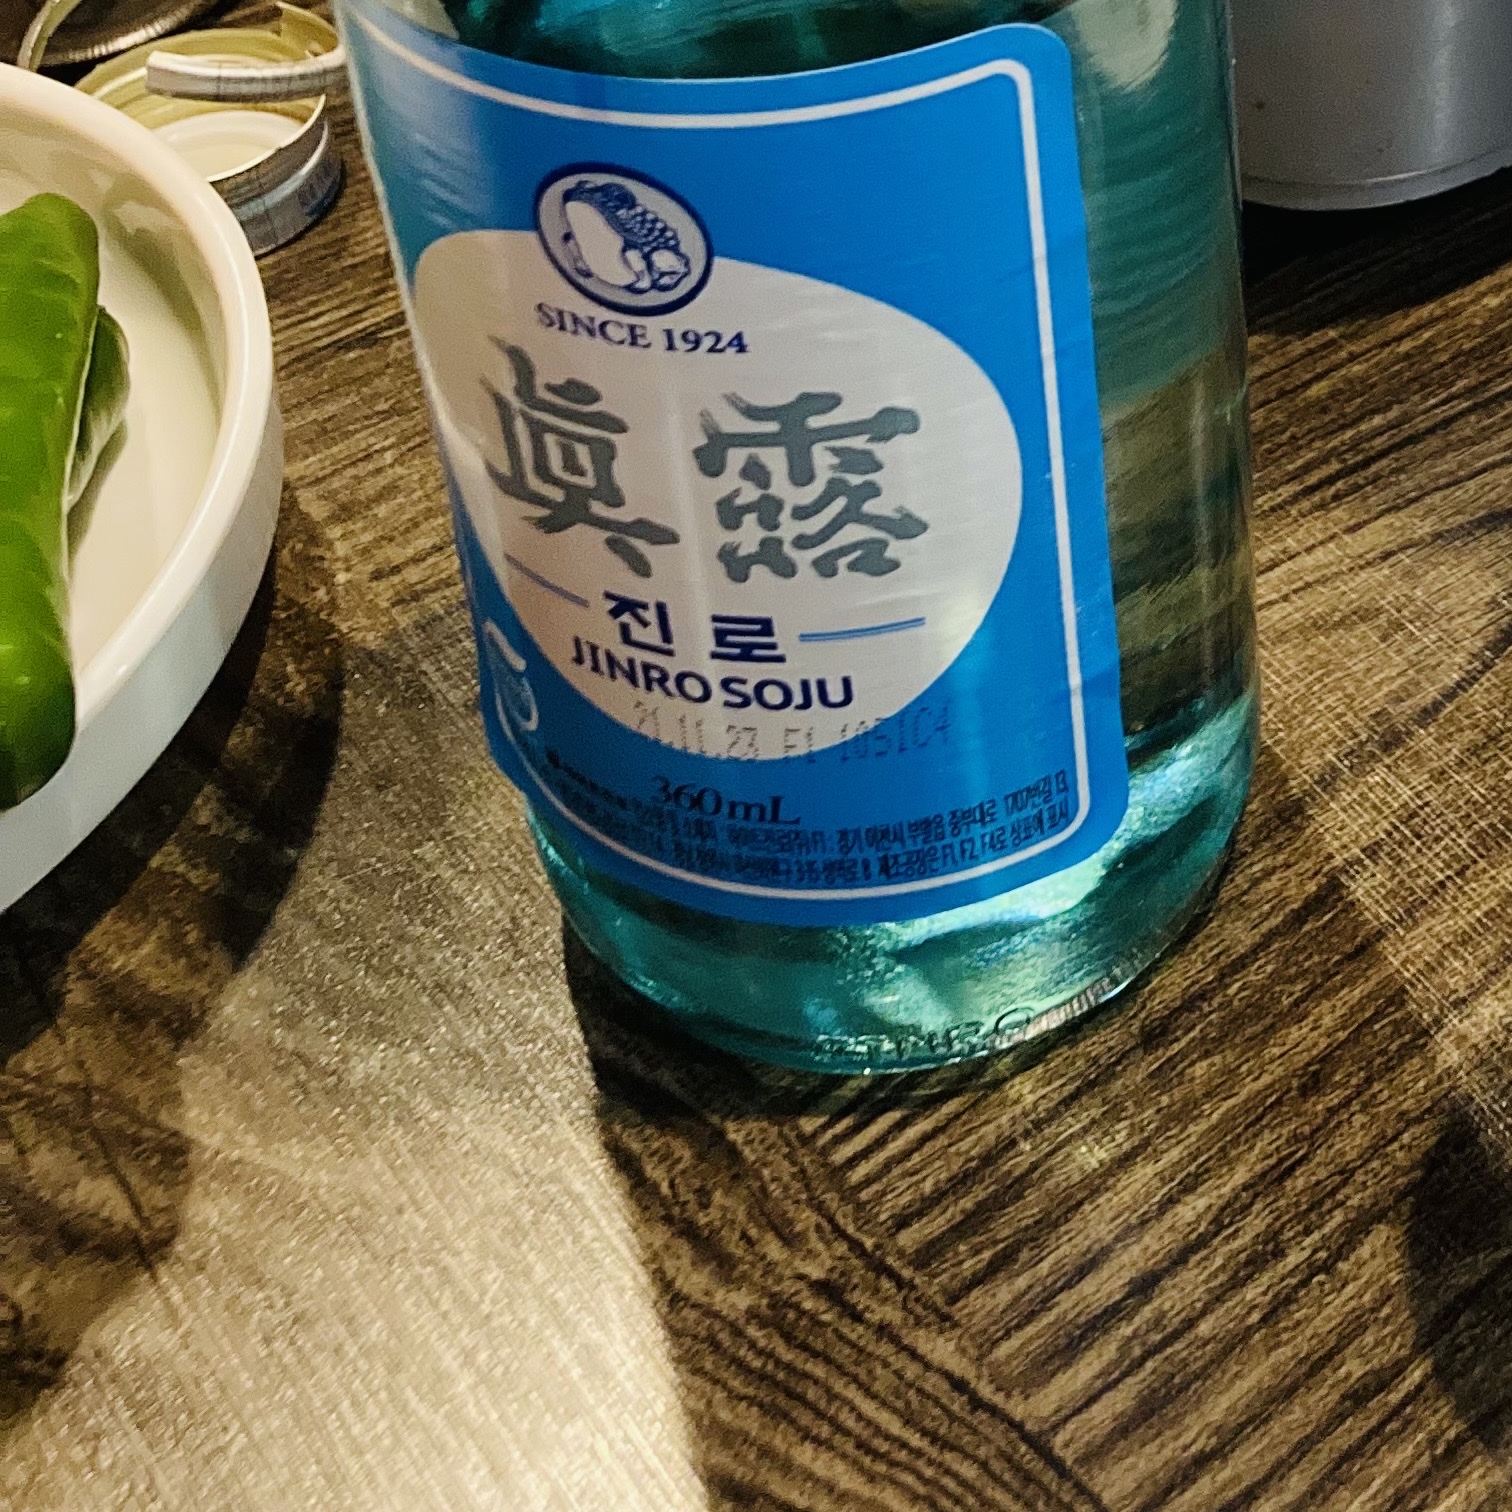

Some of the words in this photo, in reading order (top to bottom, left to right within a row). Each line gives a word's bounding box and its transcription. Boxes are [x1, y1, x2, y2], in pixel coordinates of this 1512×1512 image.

[534, 302, 652, 350] SINCE
[662, 327, 750, 354] 1924
[571, 635, 713, 704] JINRO
[720, 675, 854, 711] SOJU
[652, 774, 801, 825] 360mL
